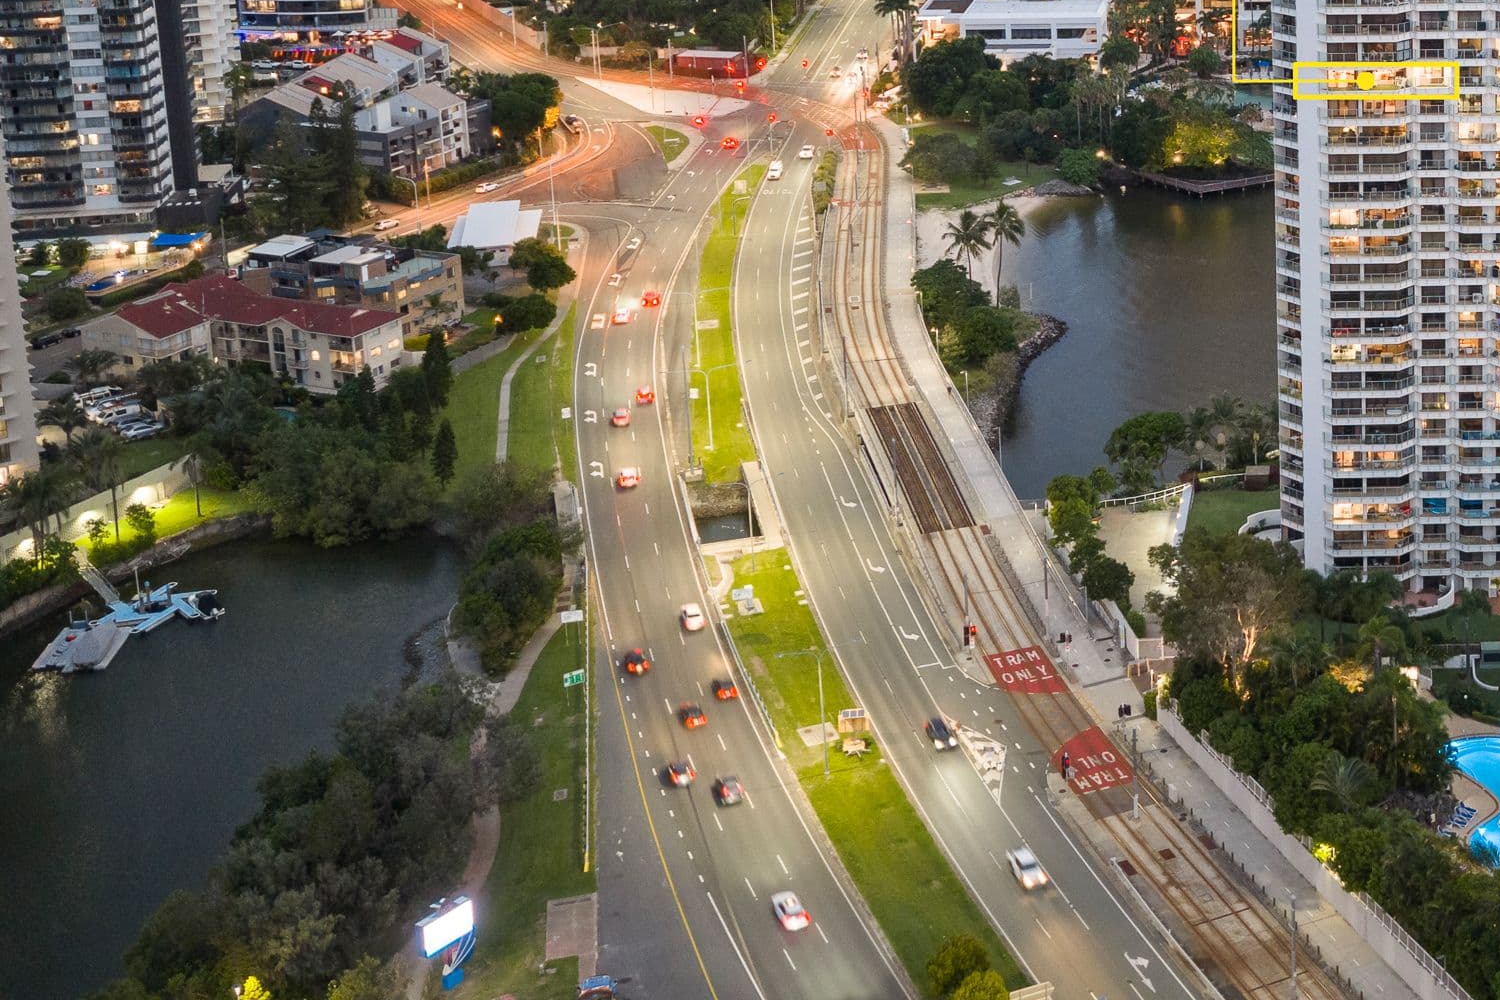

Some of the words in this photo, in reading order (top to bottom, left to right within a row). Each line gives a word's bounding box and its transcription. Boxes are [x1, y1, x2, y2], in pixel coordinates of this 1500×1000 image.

[993, 650, 1041, 668] TRAM
[1001, 665, 1050, 684] ONLY
[1074, 767, 1129, 790] TRAM
